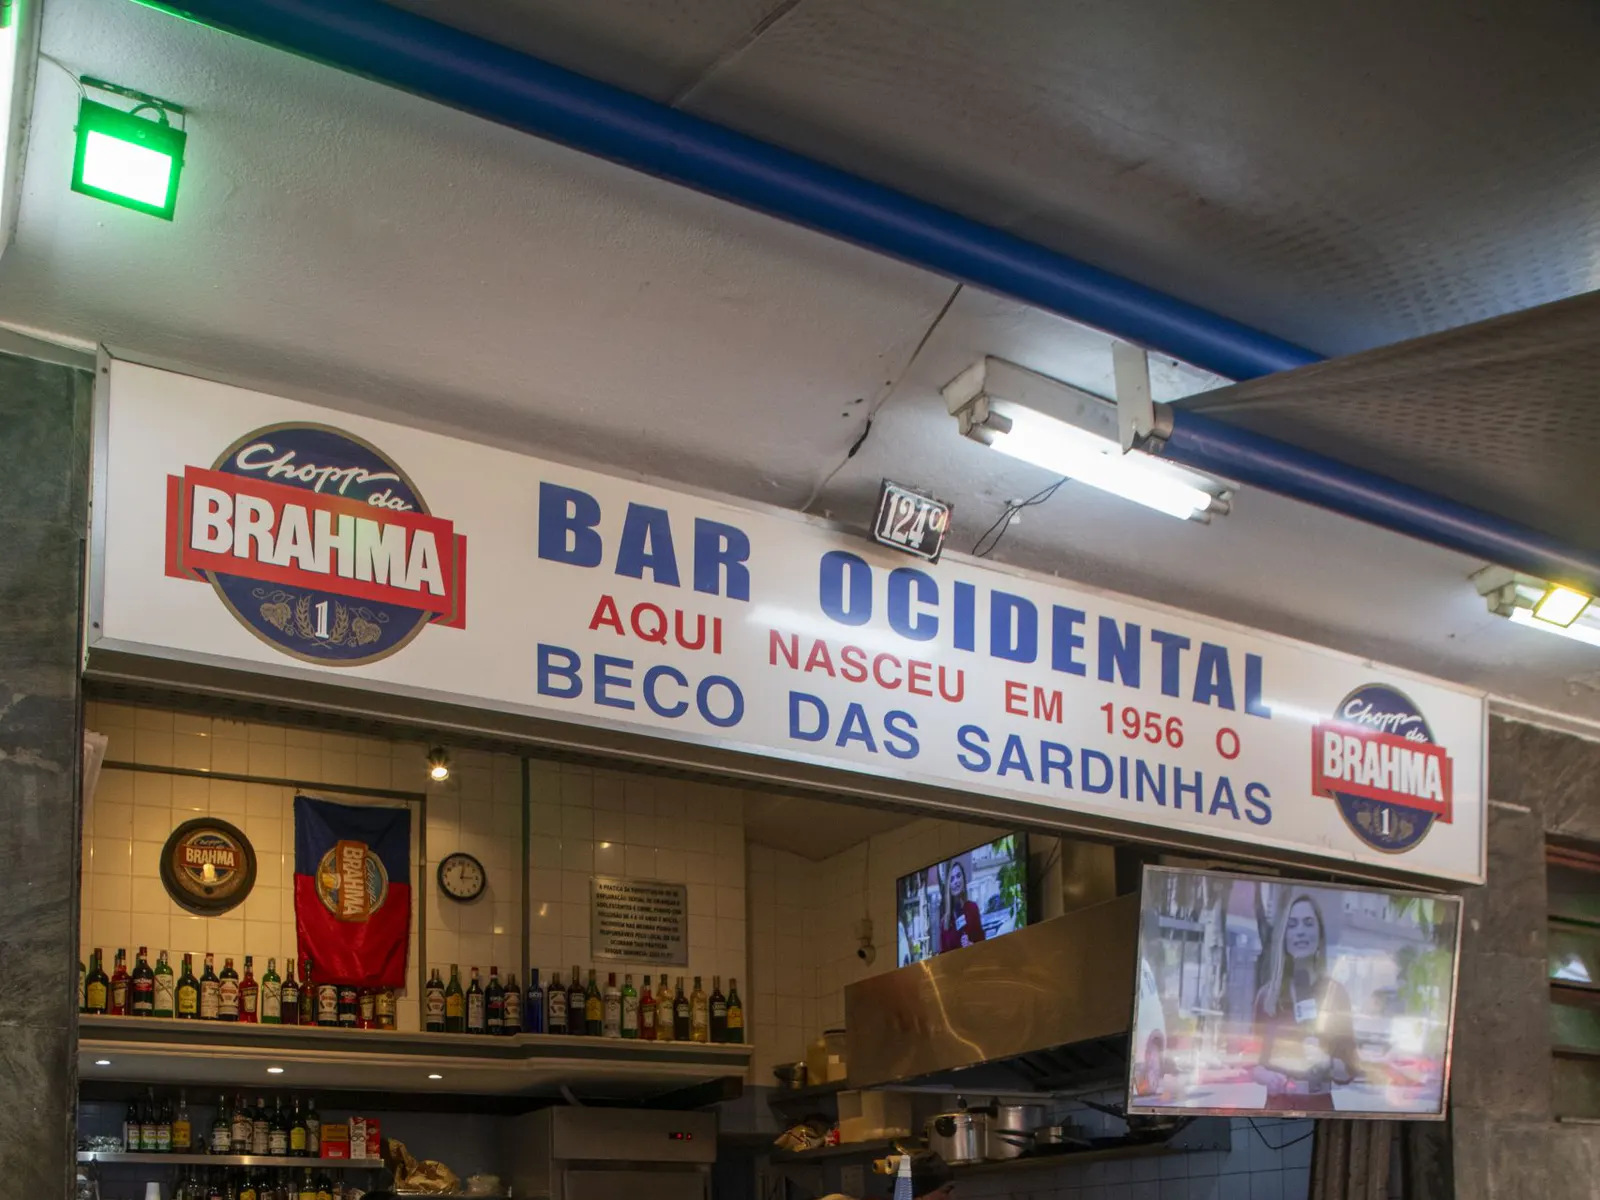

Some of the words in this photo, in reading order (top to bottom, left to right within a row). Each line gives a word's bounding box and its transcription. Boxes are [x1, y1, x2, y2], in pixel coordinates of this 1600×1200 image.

[236, 443, 400, 493] Chopp
[368, 489, 412, 511] da
[191, 484, 446, 597] BRAHMA
[315, 601, 329, 639] 1
[538, 481, 751, 602] BAR
[819, 549, 1272, 720] OCIDENTAL
[589, 595, 722, 655] AQUI
[769, 629, 965, 703] NASCEU
[1005, 680, 1063, 724] EM
[1101, 702, 1184, 749] 1956
[1216, 727, 1241, 761] O
[536, 643, 746, 728] BECO
[788, 691, 920, 761] DAS
[957, 723, 1273, 826] SARDINHAS
[1344, 699, 1422, 732] Chopp
[1405, 727, 1429, 743] da
[1323, 731, 1445, 802] BRAHMA
[1381, 808, 1390, 835] 1
[186, 847, 235, 867] BRAHMA
[343, 846, 364, 915] BRAHMA
